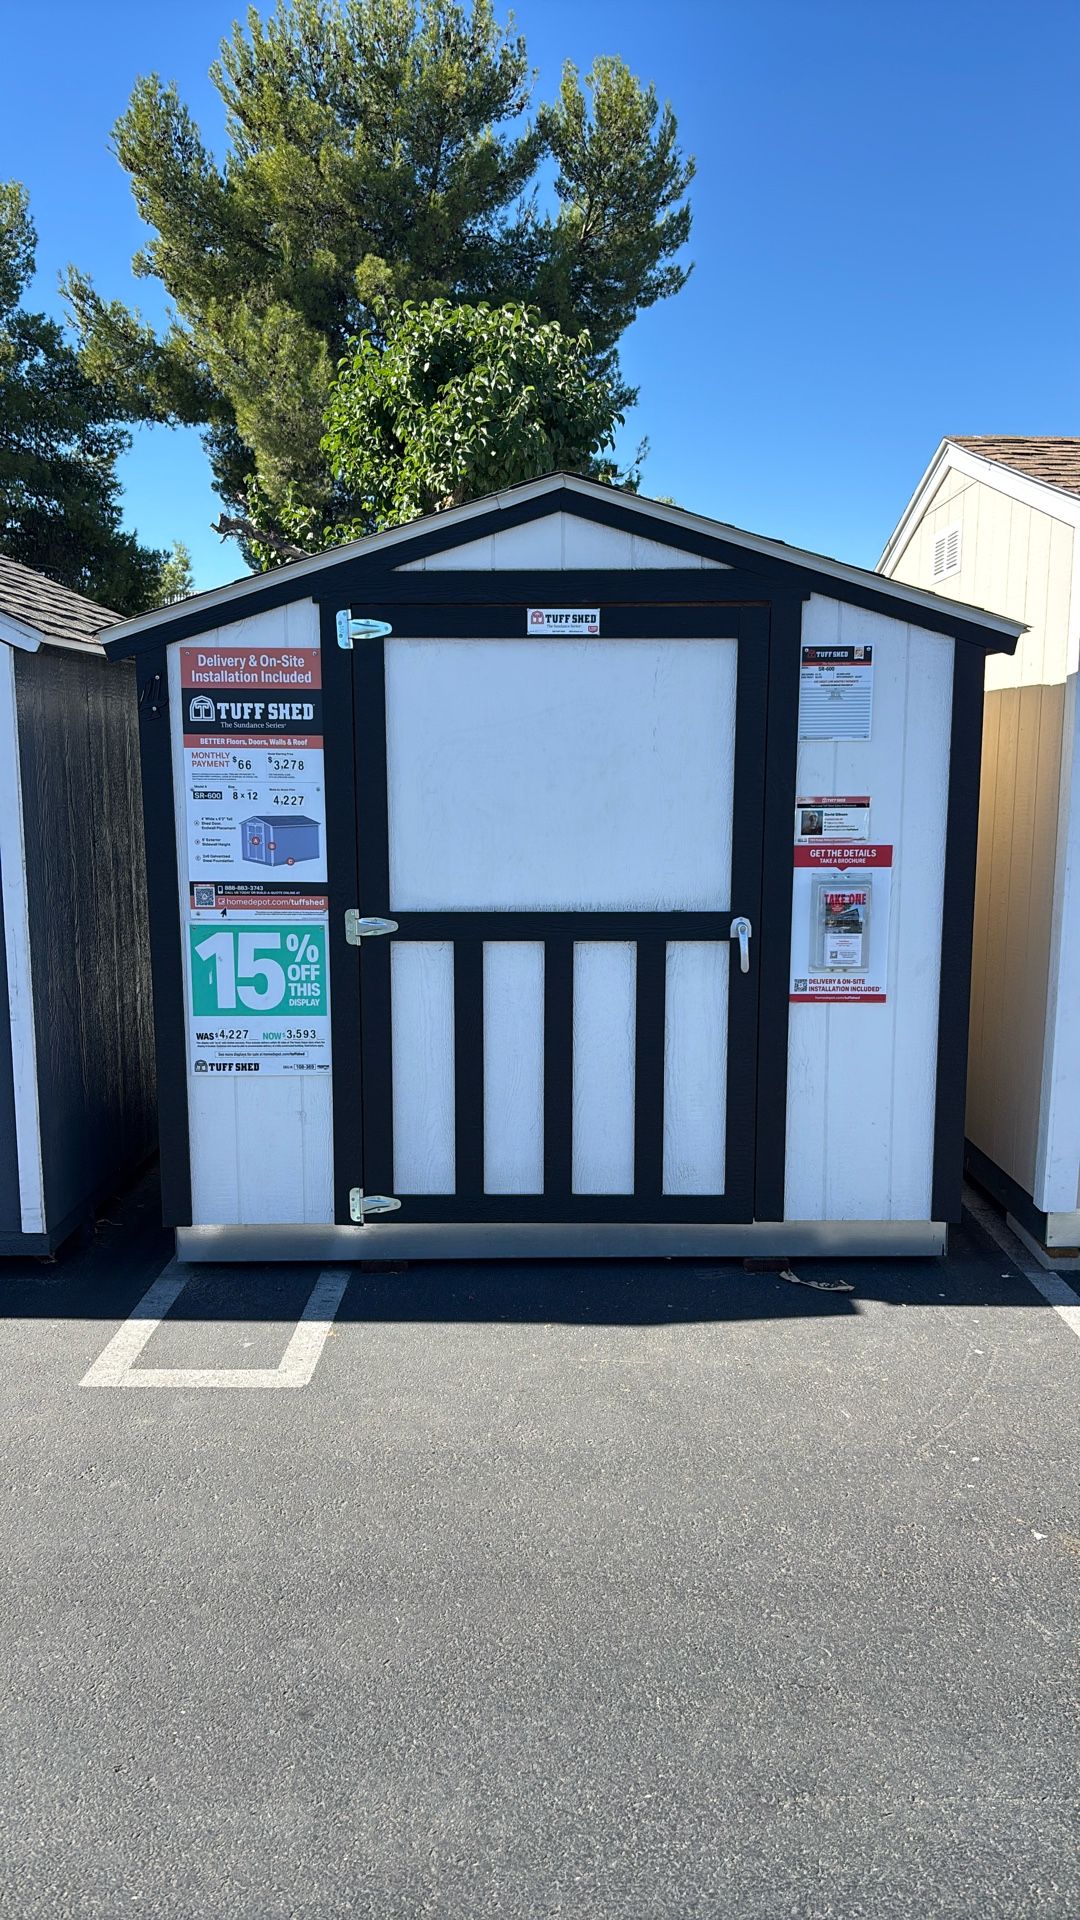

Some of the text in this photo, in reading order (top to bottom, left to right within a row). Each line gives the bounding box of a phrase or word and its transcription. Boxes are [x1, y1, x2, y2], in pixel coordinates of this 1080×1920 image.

[545, 614, 596, 624] TUFF SHED
[197, 654, 305, 670] Delivery & On-Site
[191, 670, 312, 683] Installation Included
[216, 702, 314, 720] TUFF SHED
[268, 756, 304, 770] $3,278
[248, 792, 258, 800] 12
[273, 796, 304, 806] 4,227
[226, 899, 324, 907] homedepot.com/tuffshed
[824, 894, 866, 905] TAKE ONE
[288, 964, 320, 980] OFF
[288, 983, 320, 996] THIS
[215, 1030, 248, 1039] $4,227
[282, 1030, 316, 1039] $3,593
[209, 1063, 259, 1071] TUFF SHED
